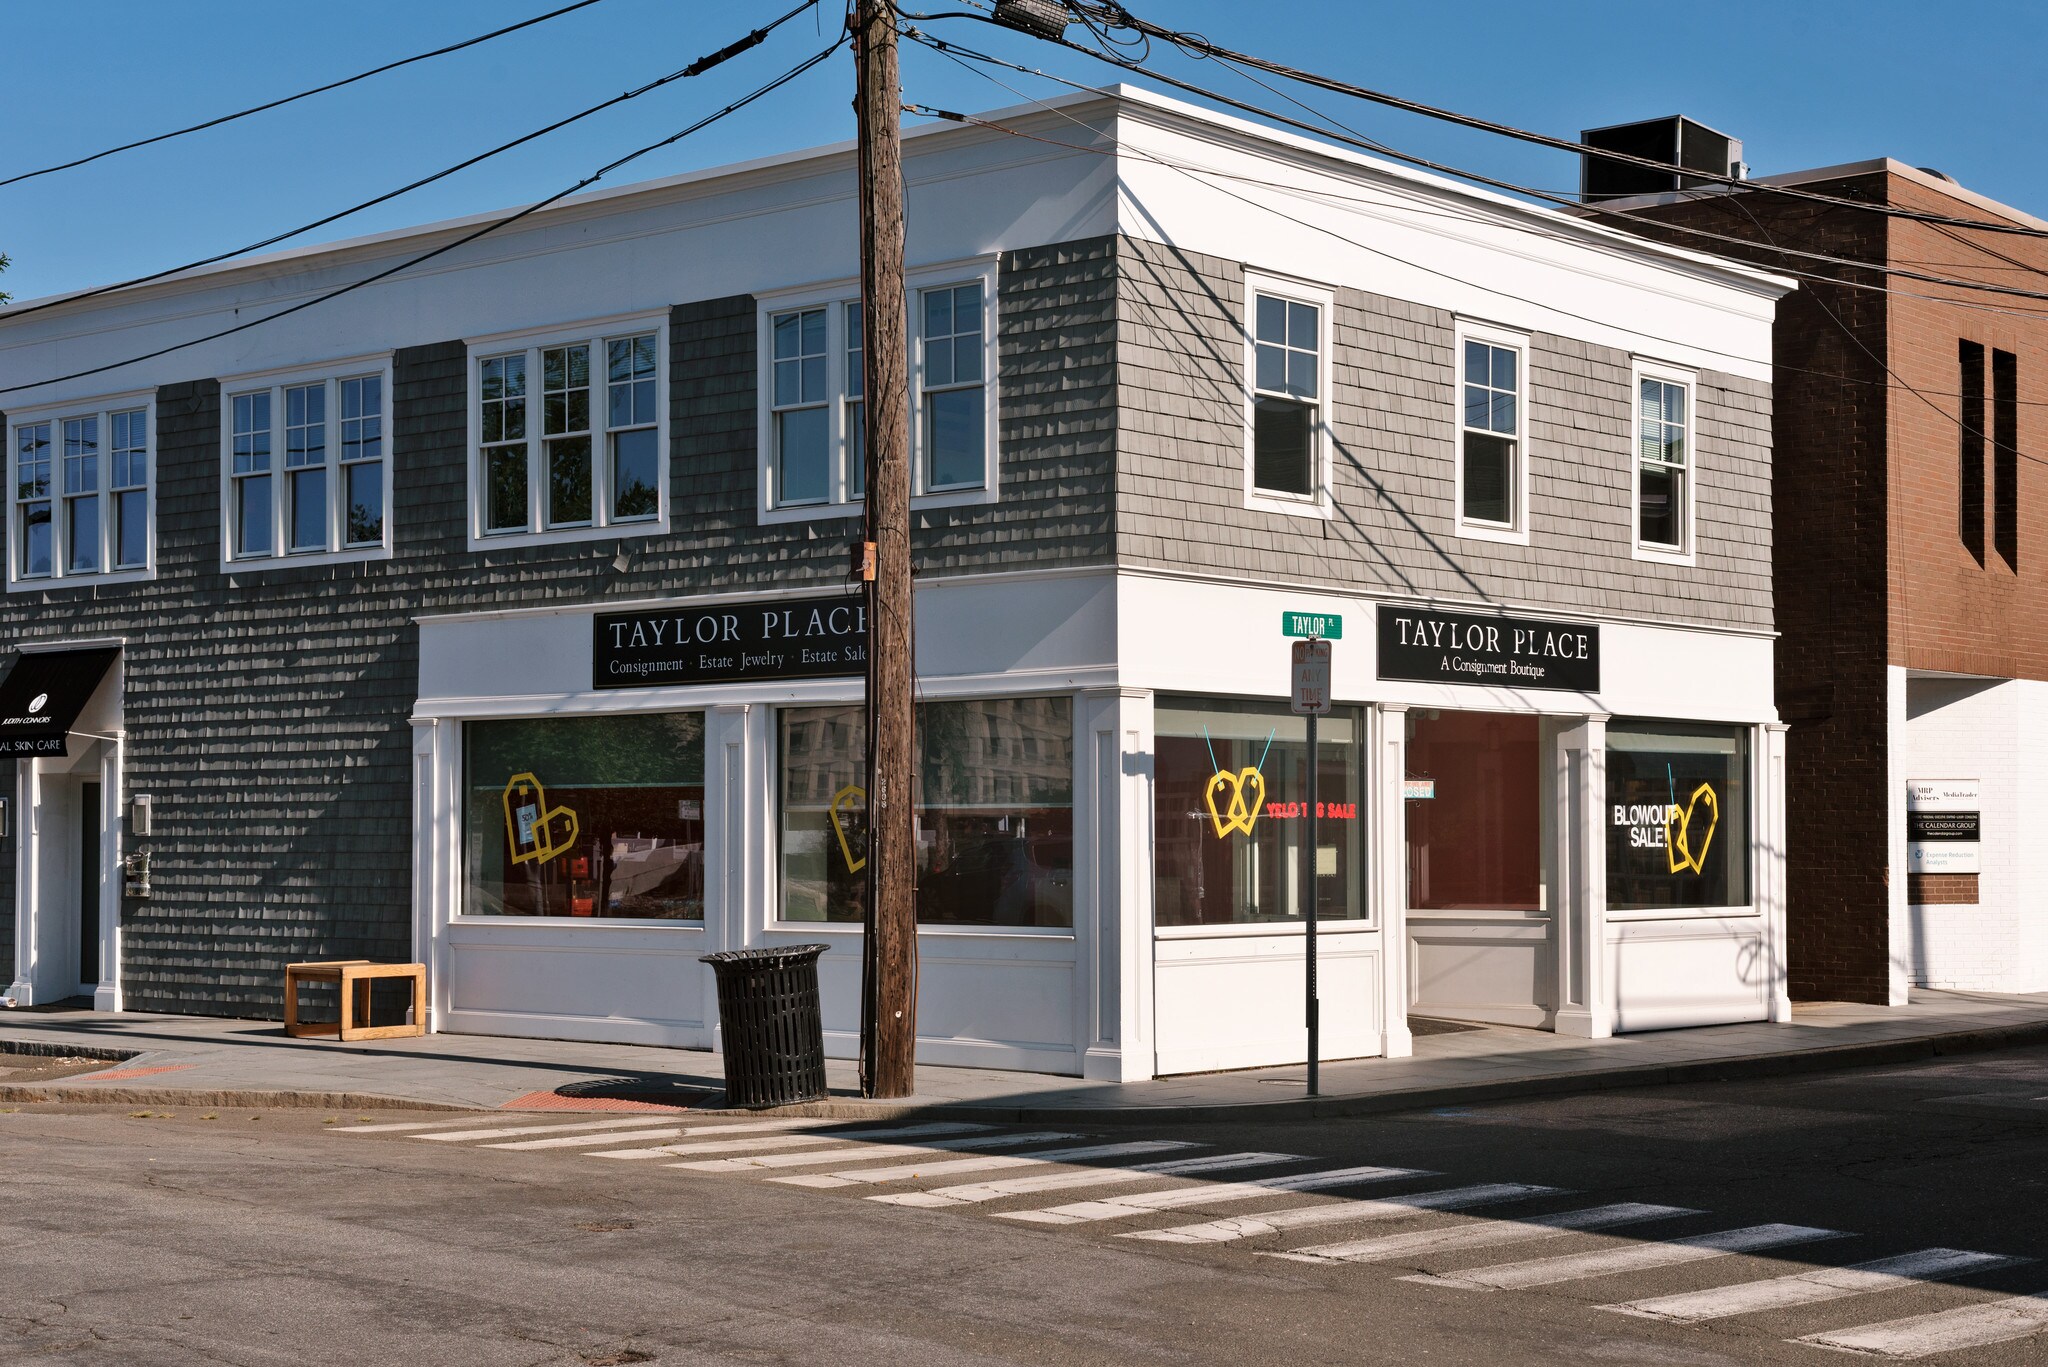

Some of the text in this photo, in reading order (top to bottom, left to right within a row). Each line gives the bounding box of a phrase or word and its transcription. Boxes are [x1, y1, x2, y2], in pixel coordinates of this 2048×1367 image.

[609, 615, 740, 648] TAYLOR
[1292, 616, 1334, 635] TAYLOR PL
[1396, 618, 1588, 660] TAYLOR PLACE
[610, 659, 683, 676] Consignment
[699, 655, 733, 669] Estate
[740, 650, 784, 671] Jewelry
[801, 648, 837, 663] Estate
[1441, 656, 1545, 680] A Consignment Boutique
[1300, 687, 1322, 701] TIME
[15, 741, 33, 751] SKIN
[37, 740, 60, 750] CARE
[1301, 802, 1325, 818] TG
[1327, 803, 1356, 818] SALE
[1614, 805, 1677, 825] BLOWOUT
